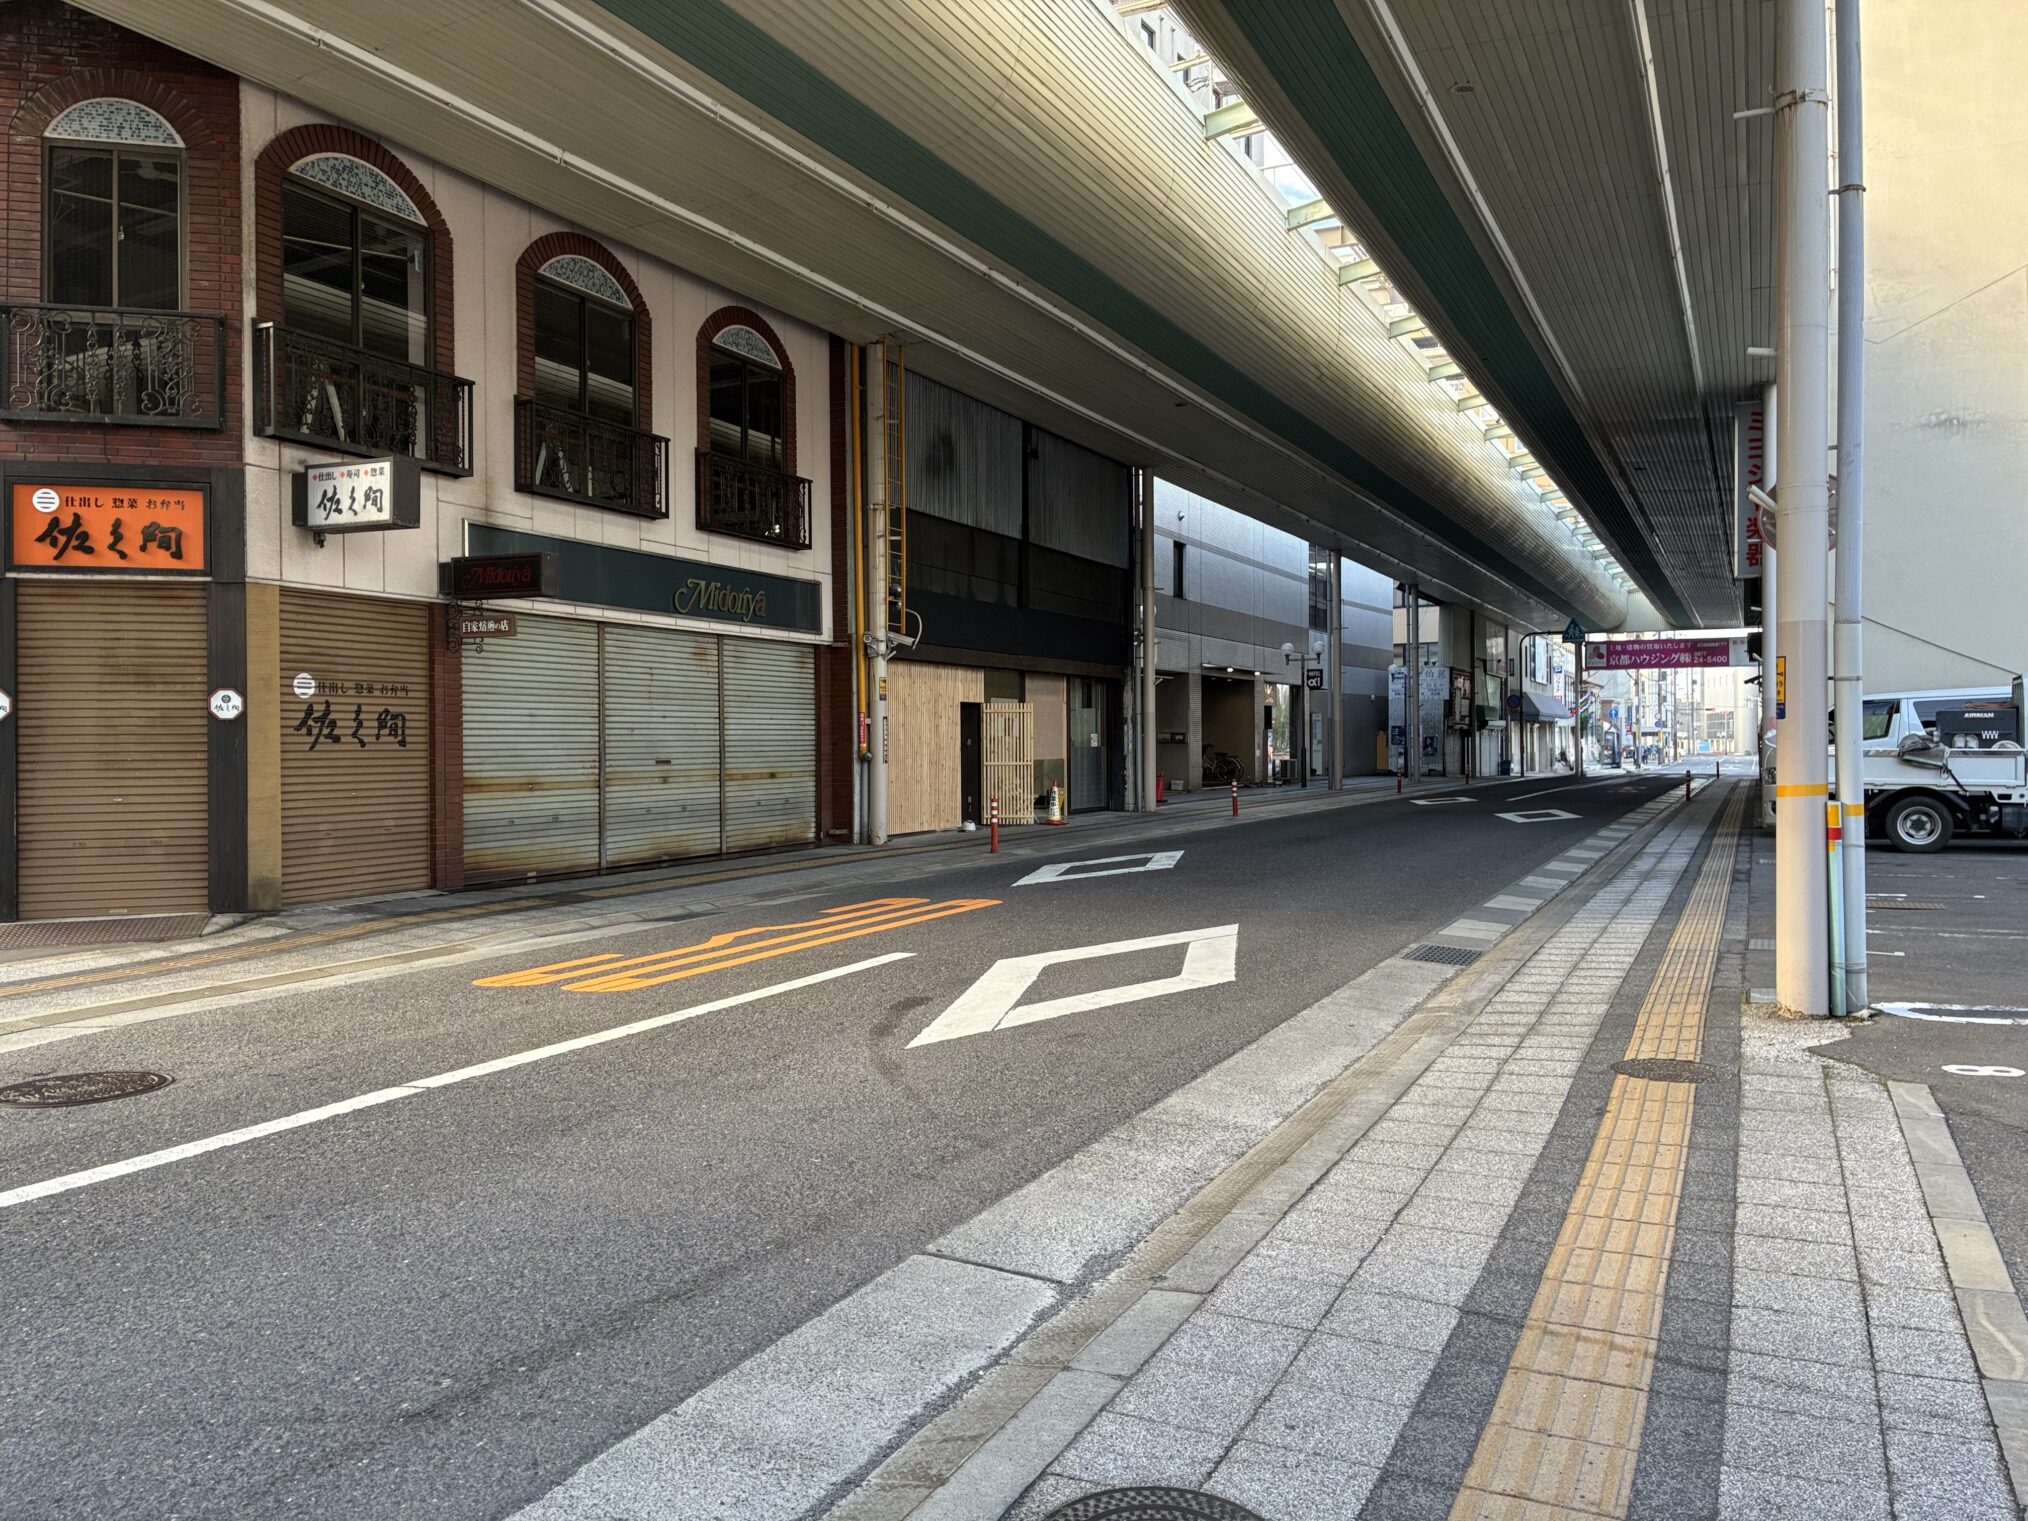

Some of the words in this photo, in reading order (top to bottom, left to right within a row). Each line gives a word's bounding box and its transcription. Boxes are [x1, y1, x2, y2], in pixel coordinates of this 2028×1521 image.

[318, 472, 337, 482] 仕出し
[346, 469, 360, 479] 寿司
[370, 467, 385, 477] 惣菜
[65, 496, 105, 508] 仕出し
[111, 497, 138, 509] 惣菜
[145, 499, 185, 511] お弁当
[674, 578, 766, 622] Midoriya
[462, 619, 509, 633] 自家焙煎の店
[1693, 655, 1728, 664] 24-5400
[317, 681, 348, 694] 仕出し
[354, 682, 374, 695] 惣菜
[379, 684, 409, 696] お弁当
